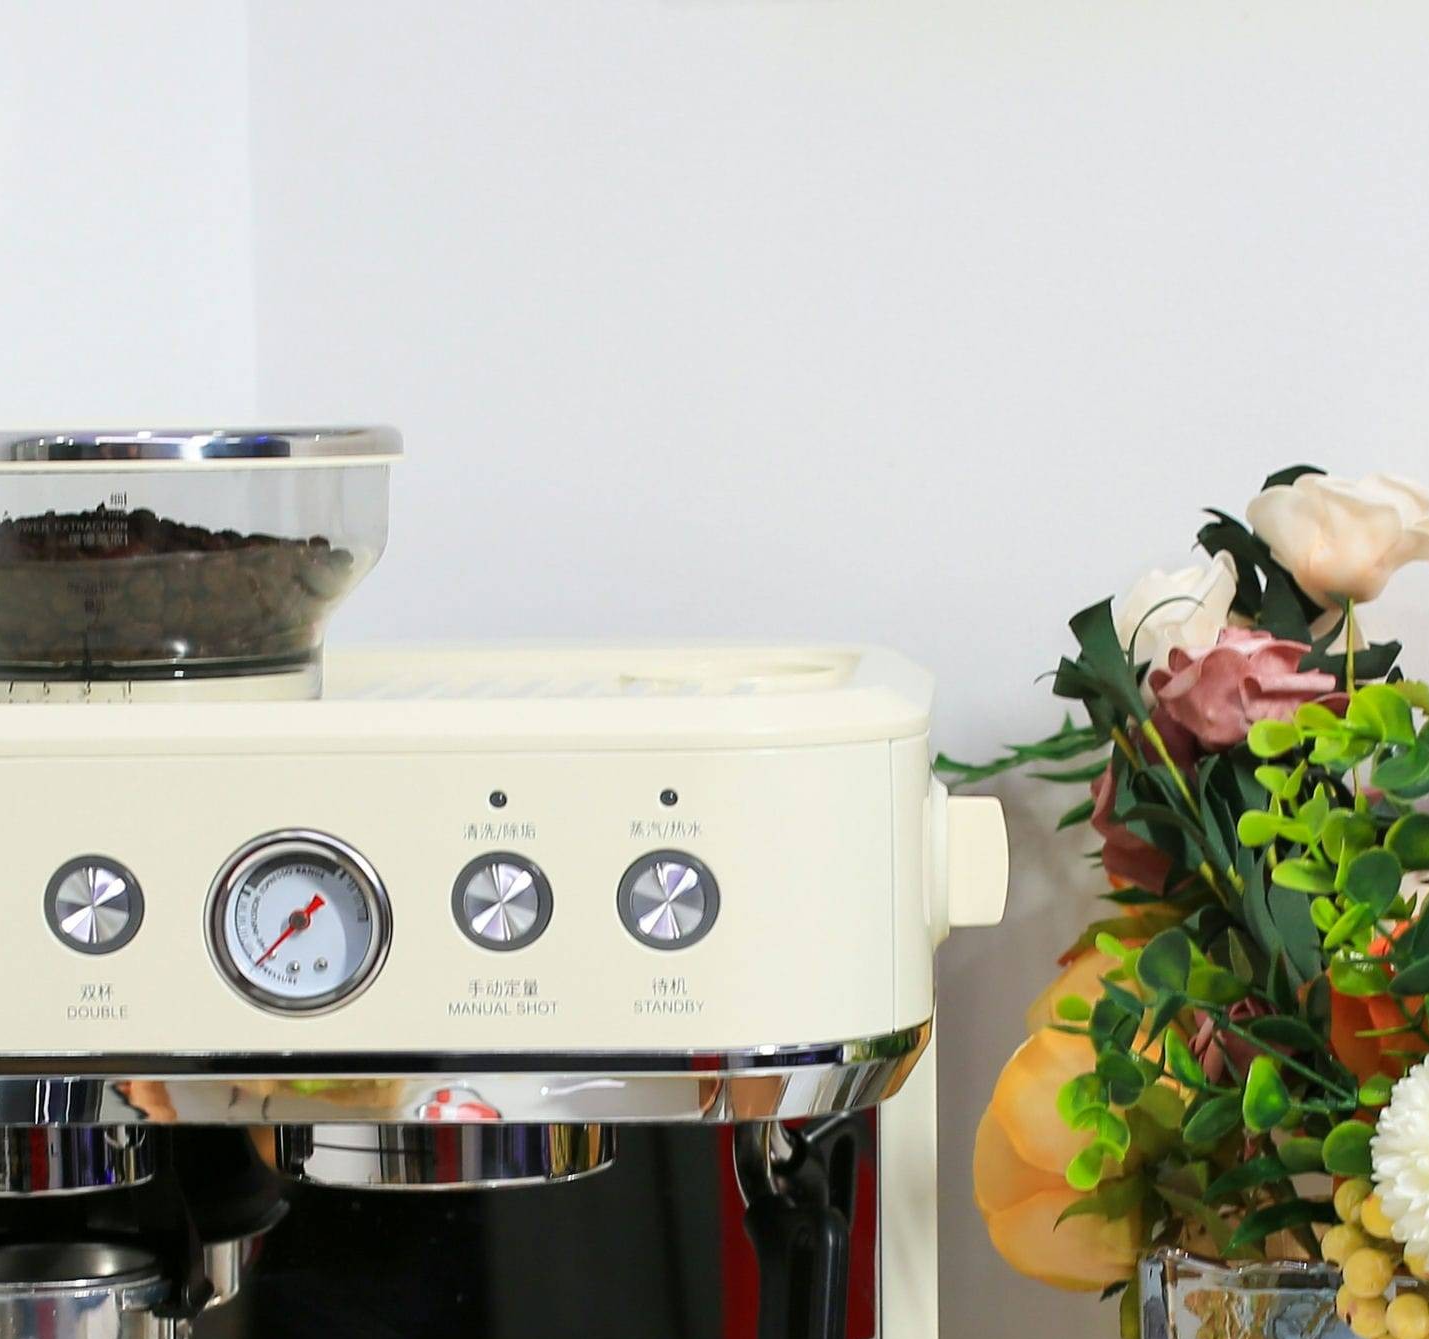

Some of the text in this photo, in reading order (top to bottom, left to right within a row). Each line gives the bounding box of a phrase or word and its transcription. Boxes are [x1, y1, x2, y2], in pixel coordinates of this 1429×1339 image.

[80, 984, 113, 1001] 双杯
[468, 979, 539, 998] 手动定量
[651, 977, 688, 997] 待机
[67, 1005, 129, 1020] DOUBLE
[448, 1000, 559, 1016] MANUAL SHOT
[634, 1000, 704, 1016] STANDBY
